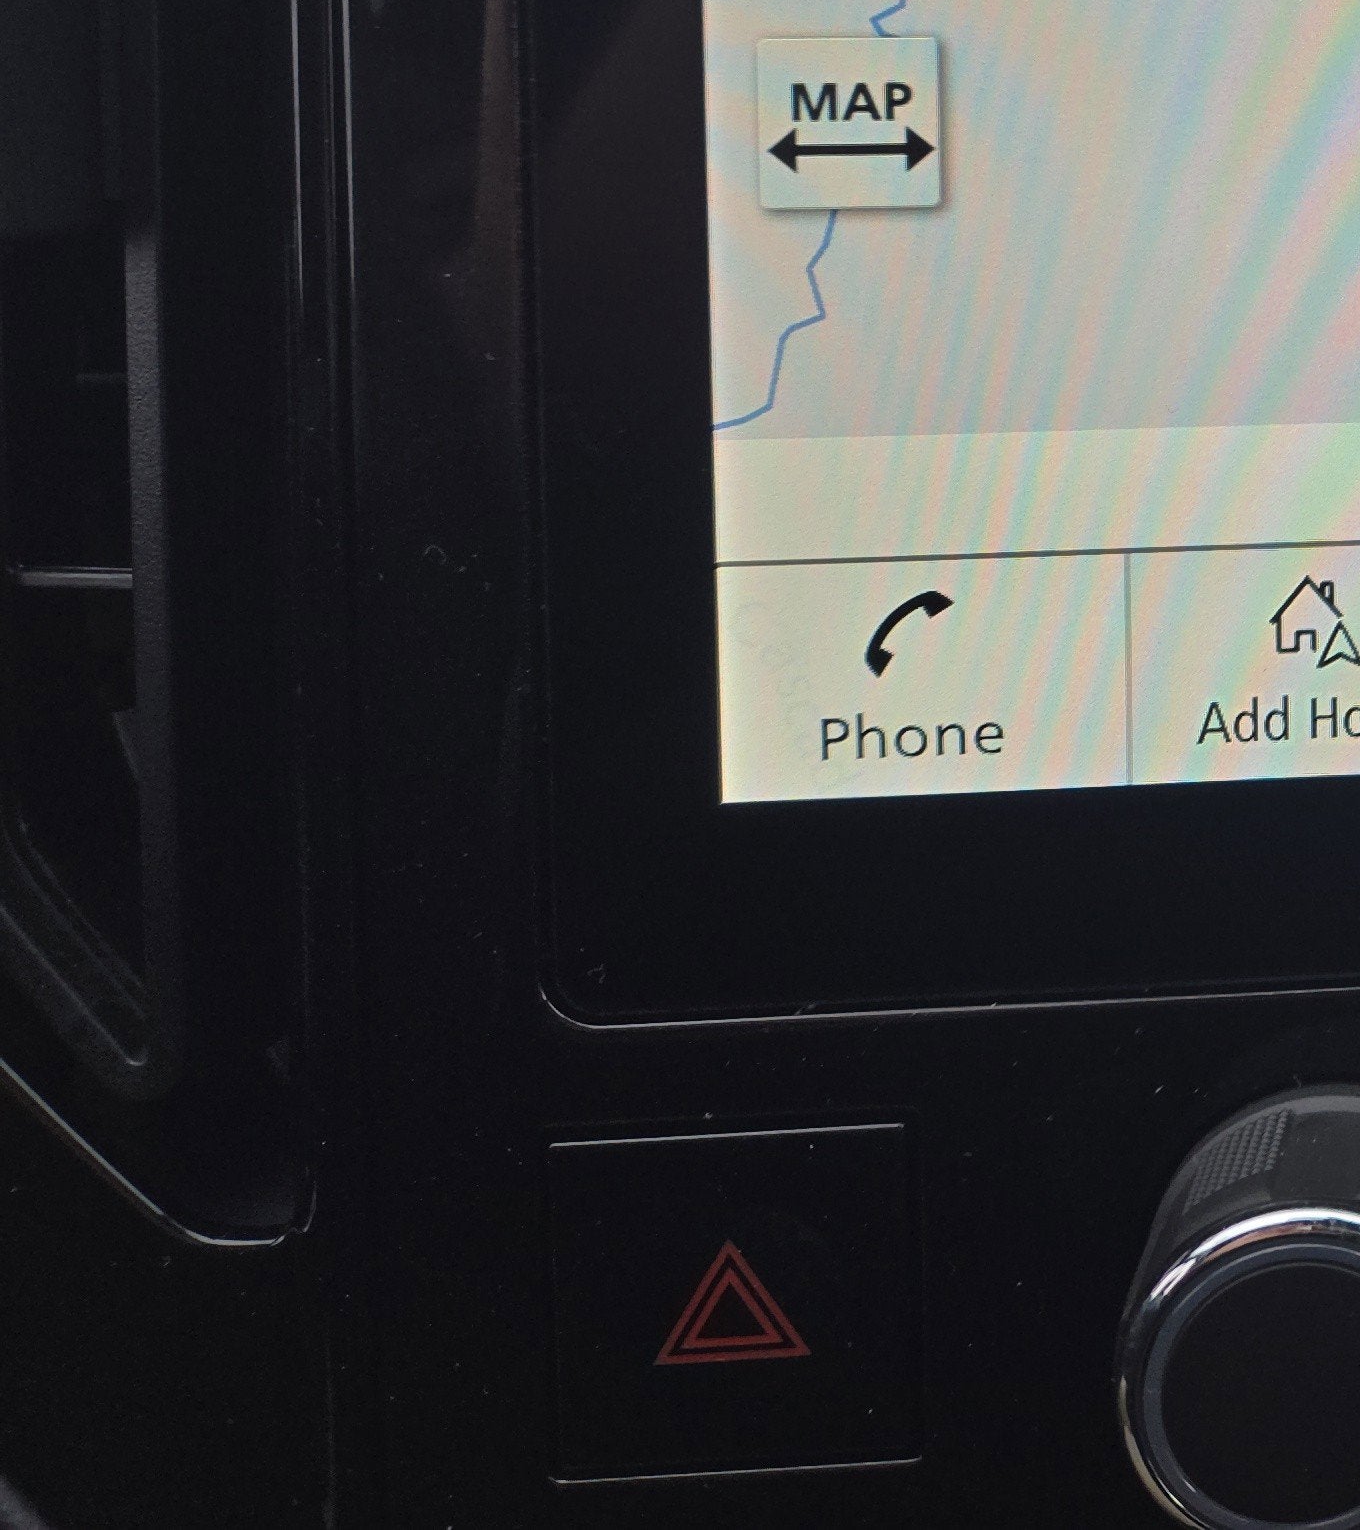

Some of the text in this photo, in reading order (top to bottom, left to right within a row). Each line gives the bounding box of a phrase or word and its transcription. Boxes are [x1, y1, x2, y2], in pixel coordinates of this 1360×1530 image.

[790, 80, 913, 122] MAP
[819, 713, 1006, 762] Phone
[1195, 696, 1292, 745] Add
